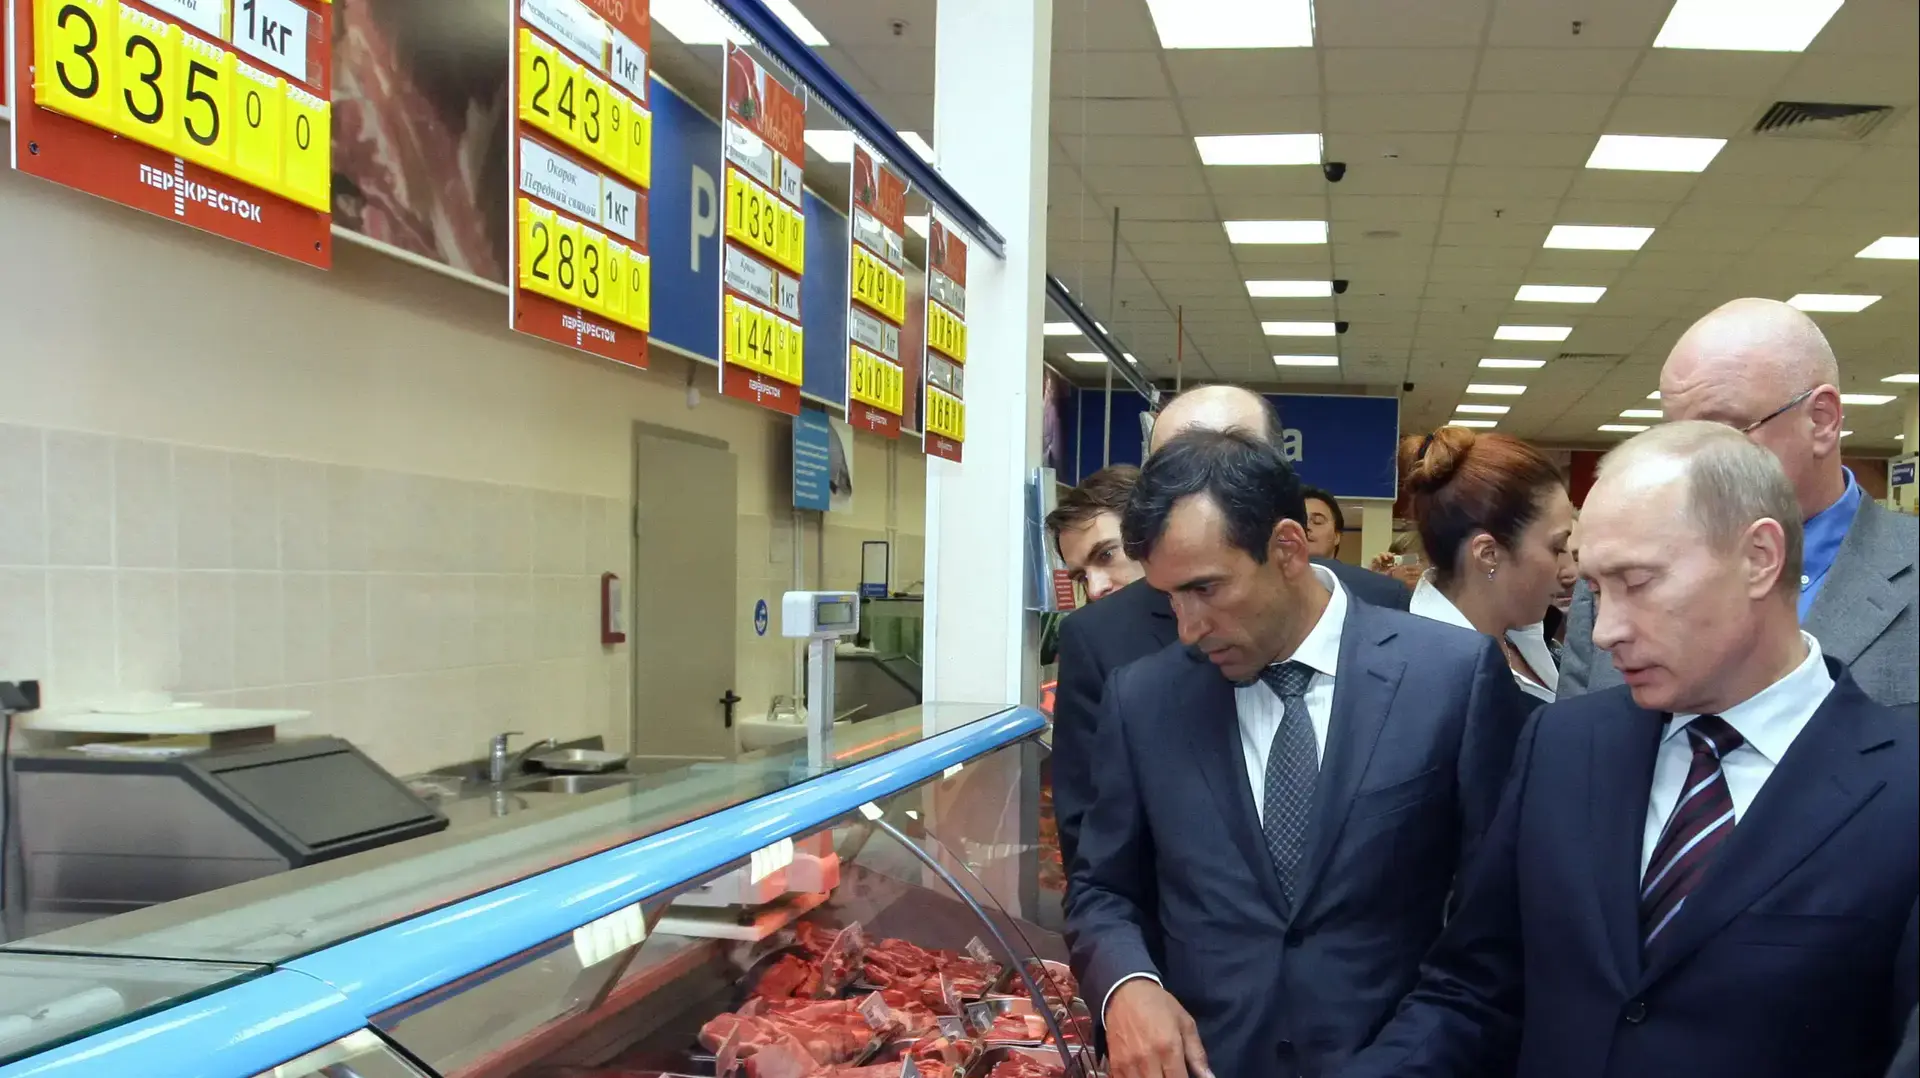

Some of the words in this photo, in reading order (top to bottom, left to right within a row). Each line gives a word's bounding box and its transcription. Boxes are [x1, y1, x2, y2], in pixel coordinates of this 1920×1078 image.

[243, 0, 293, 57] 1кг
[616, 46, 639, 84] 1кг
[532, 56, 600, 144] 243
[140, 157, 262, 224] ПЕРЕКРЕСТОК
[524, 171, 567, 204] Передний
[567, 196, 597, 218] свиной
[546, 158, 577, 186] Окорок
[783, 168, 797, 196] 1кг
[605, 190, 629, 226] 1кг
[737, 188, 774, 247] 133
[531, 221, 600, 299] 283
[562, 313, 616, 345] ПЕРЕКРЕСТОК
[736, 312, 773, 365] 144
